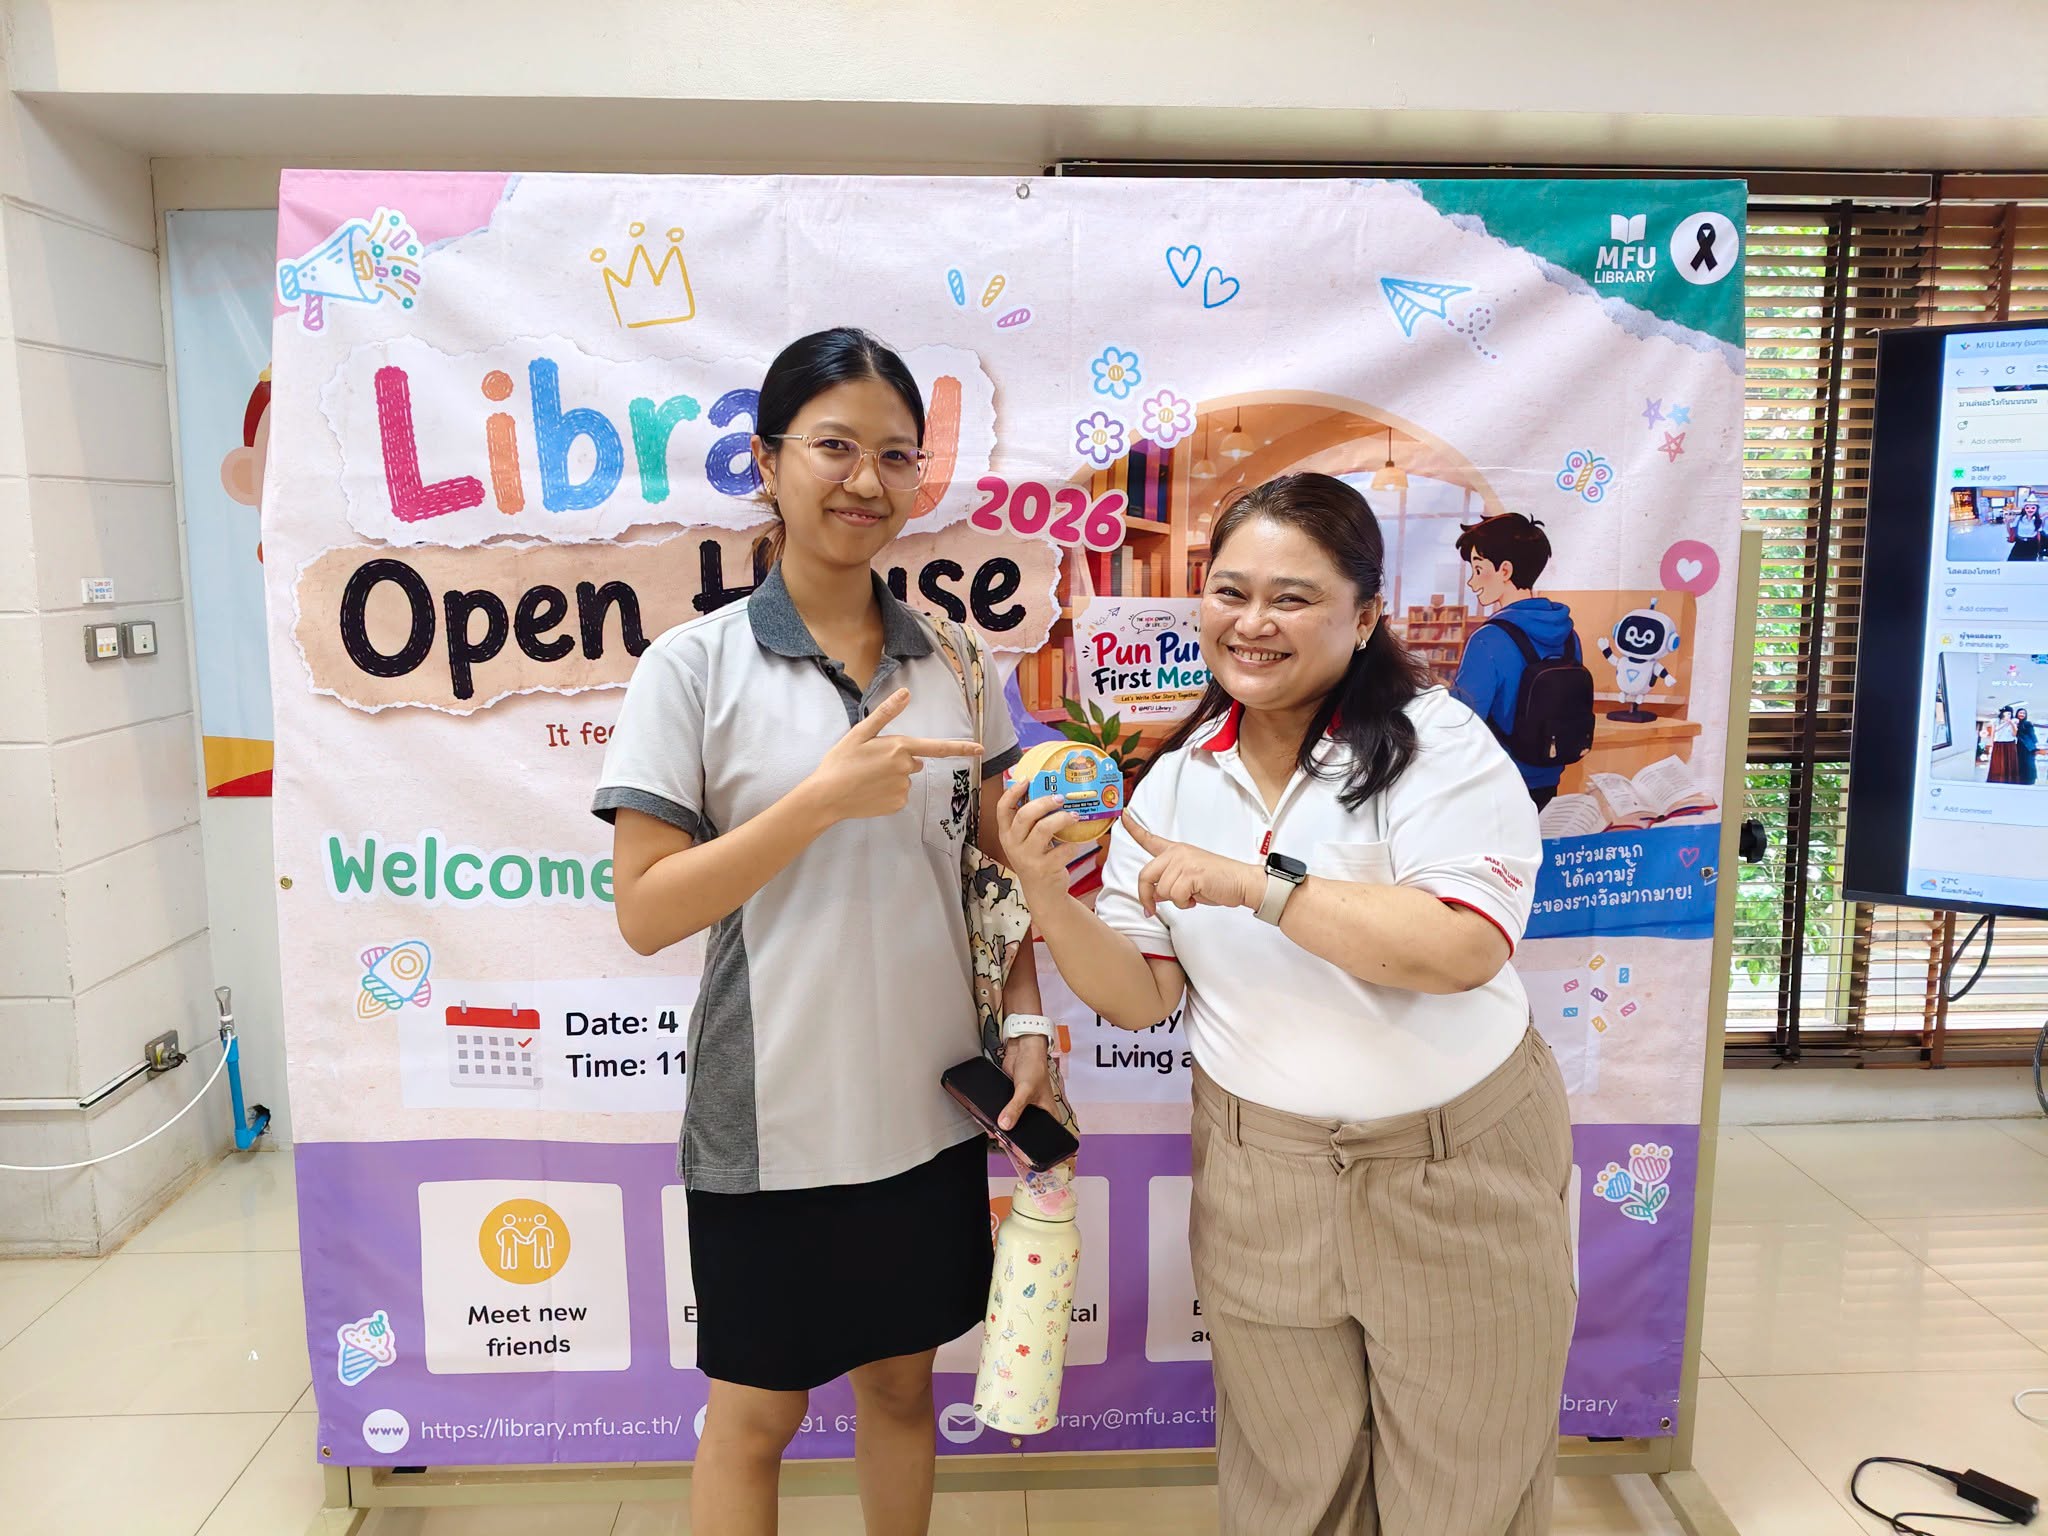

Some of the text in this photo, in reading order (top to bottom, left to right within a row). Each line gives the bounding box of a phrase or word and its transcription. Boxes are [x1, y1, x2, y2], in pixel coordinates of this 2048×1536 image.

[1596, 246, 1656, 270] MFU
[1594, 270, 1656, 284] LIBRARY
[1996, 340, 2022, 349] Library
[1993, 474, 2007, 482] ago
[971, 476, 1125, 548] 2026
[339, 557, 652, 700] Open
[1091, 632, 1151, 668] Pun
[1091, 667, 1152, 696] First
[545, 723, 571, 748] It
[1555, 844, 1643, 867] มาร่วมสนุก
[328, 836, 616, 902] Welcome
[1562, 861, 1638, 888] ได้ความรู้
[566, 1010, 679, 1036] Date: 4
[565, 1053, 646, 1078] Time:
[1096, 1044, 1174, 1075] Living
[468, 1304, 588, 1326] Meet new
[486, 1335, 571, 1357] friends
[421, 1415, 682, 1442] https://library.mfu.ac.th/
